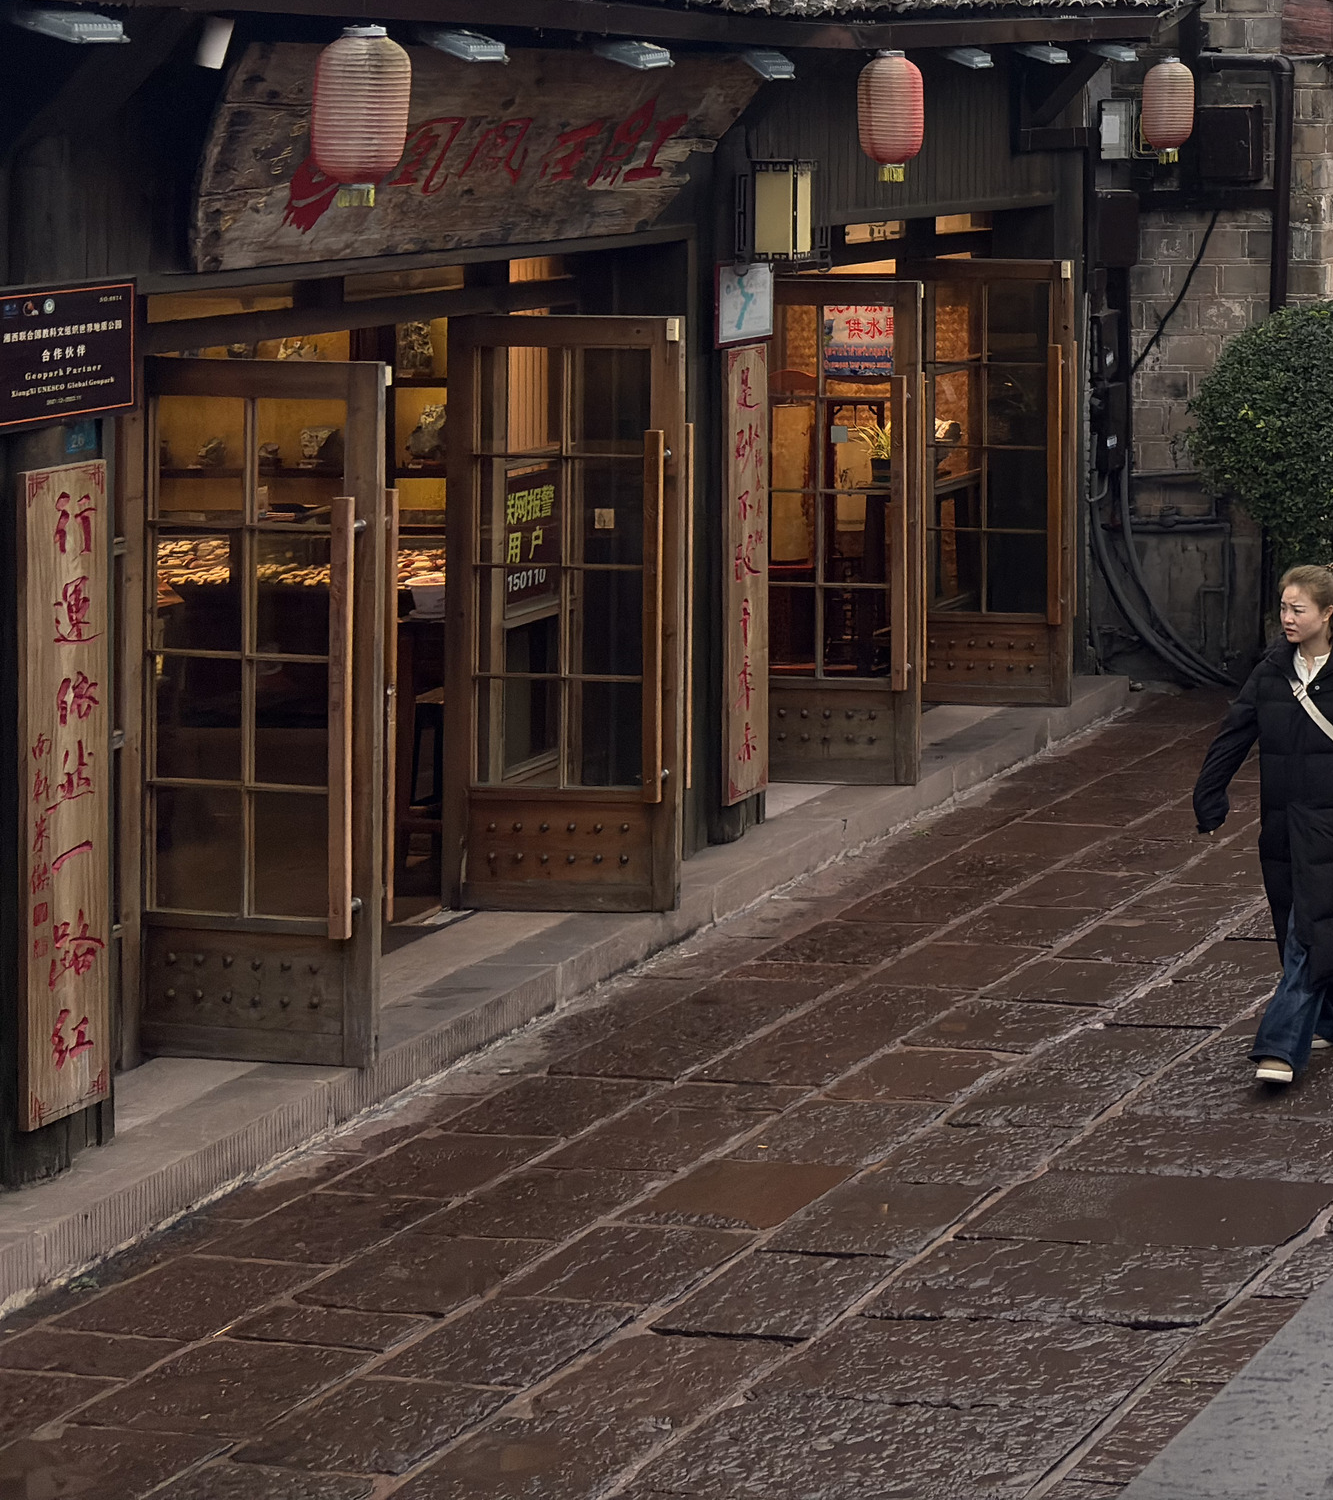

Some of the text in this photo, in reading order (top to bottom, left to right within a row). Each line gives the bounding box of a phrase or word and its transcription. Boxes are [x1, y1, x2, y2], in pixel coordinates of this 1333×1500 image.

[3, 319, 123, 344] 湘西联合国教科文组织世界地质公园
[41, 344, 86, 363] 合作伙伴
[25, 364, 102, 381] Geopark Partner
[37, 383, 65, 394] UNESCO
[67, 379, 88, 390] Global
[89, 376, 115, 387] Geopark
[71, 434, 85, 448] 26
